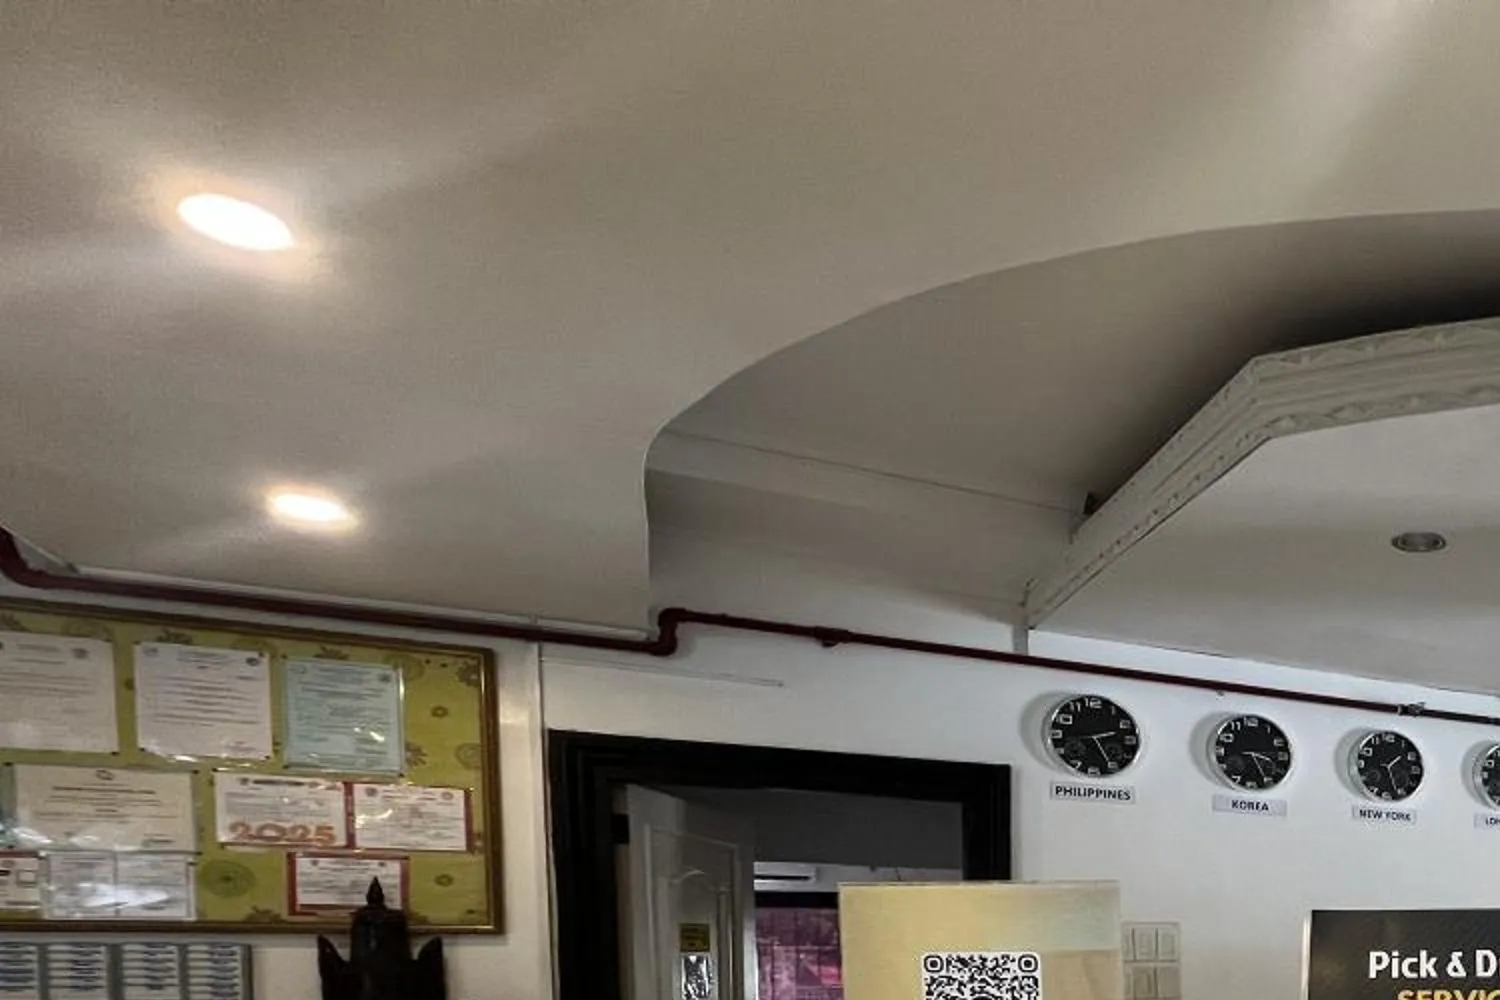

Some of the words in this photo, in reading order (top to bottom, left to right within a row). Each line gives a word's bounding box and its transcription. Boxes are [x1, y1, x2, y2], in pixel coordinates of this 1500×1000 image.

[1055, 785, 1131, 801] PHILIPPINES
[1231, 799, 1270, 811] KOREA
[229, 822, 336, 845] 2025
[1368, 950, 1438, 979] Pick
[1445, 951, 1467, 979] &
